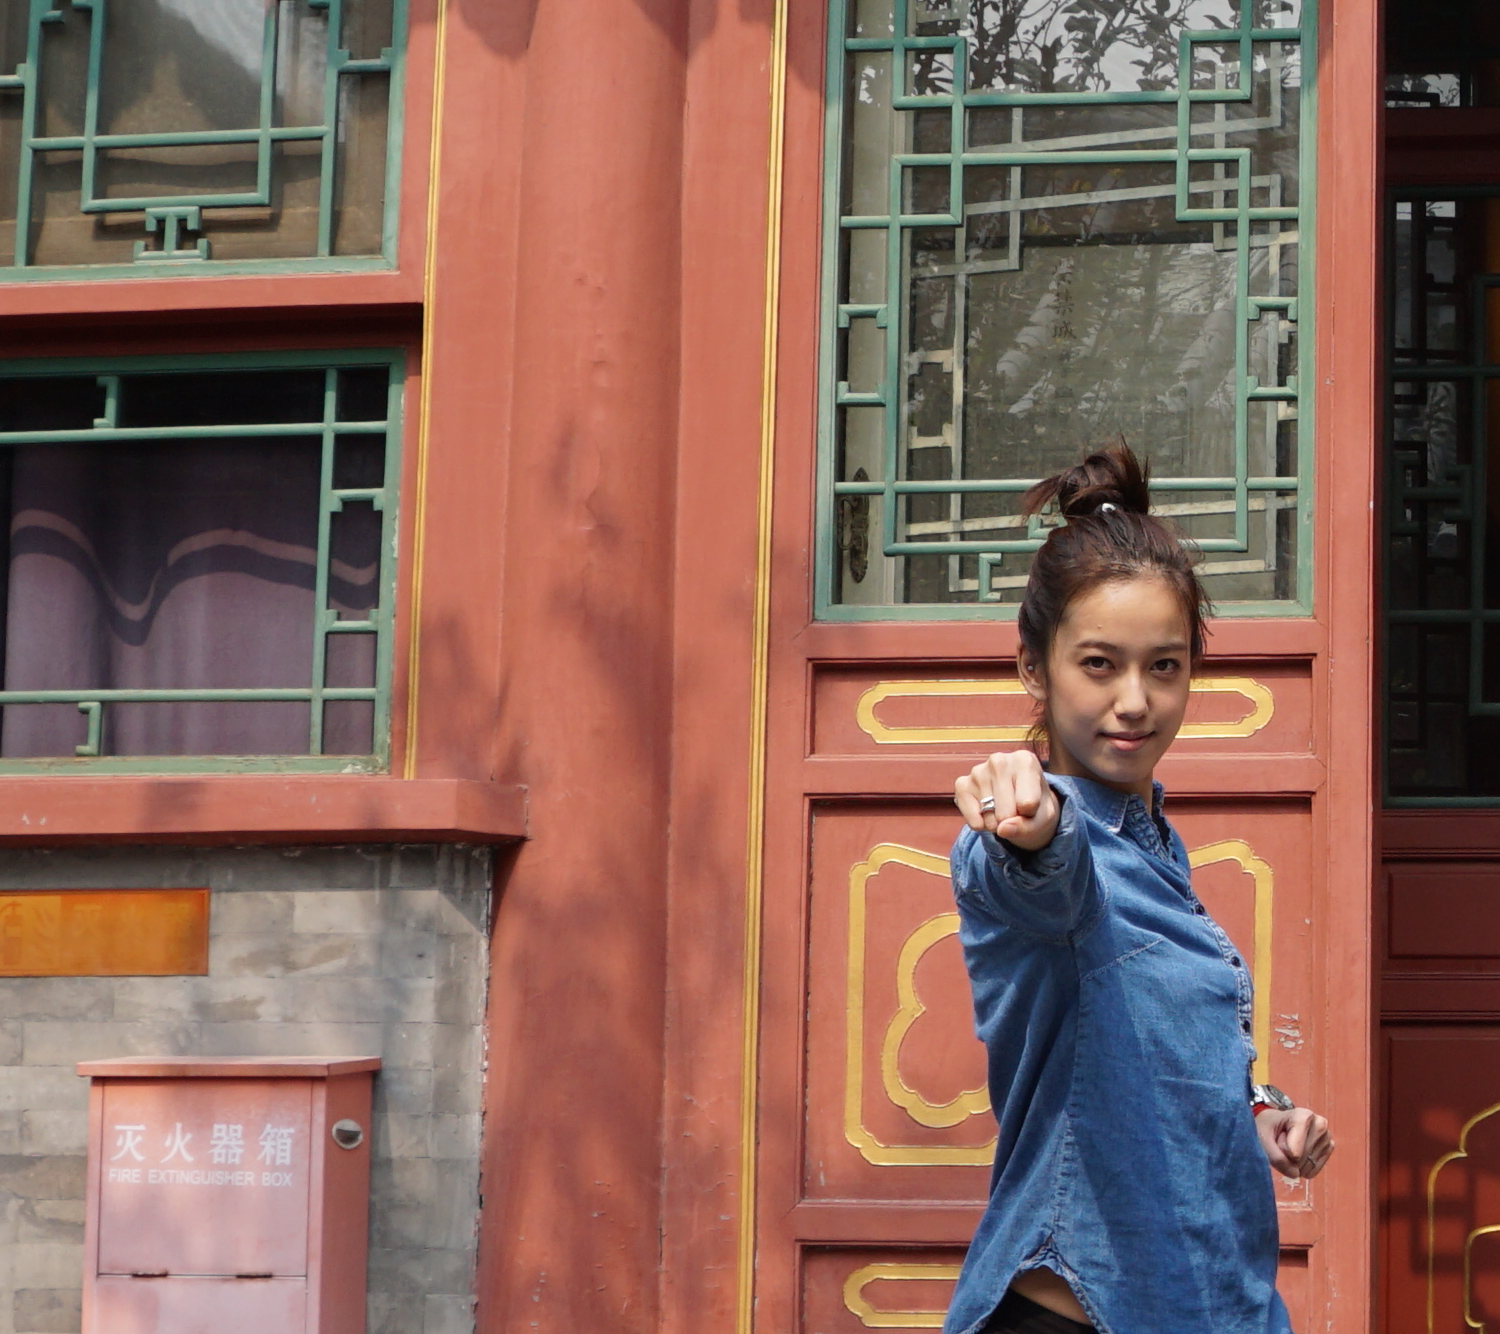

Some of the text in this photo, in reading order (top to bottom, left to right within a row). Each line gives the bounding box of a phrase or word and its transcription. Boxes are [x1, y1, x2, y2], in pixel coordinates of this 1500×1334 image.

[109, 1122, 296, 1167] 灭火器箱
[108, 1168, 294, 1188] FIRE EXTINGUISHER BOX
